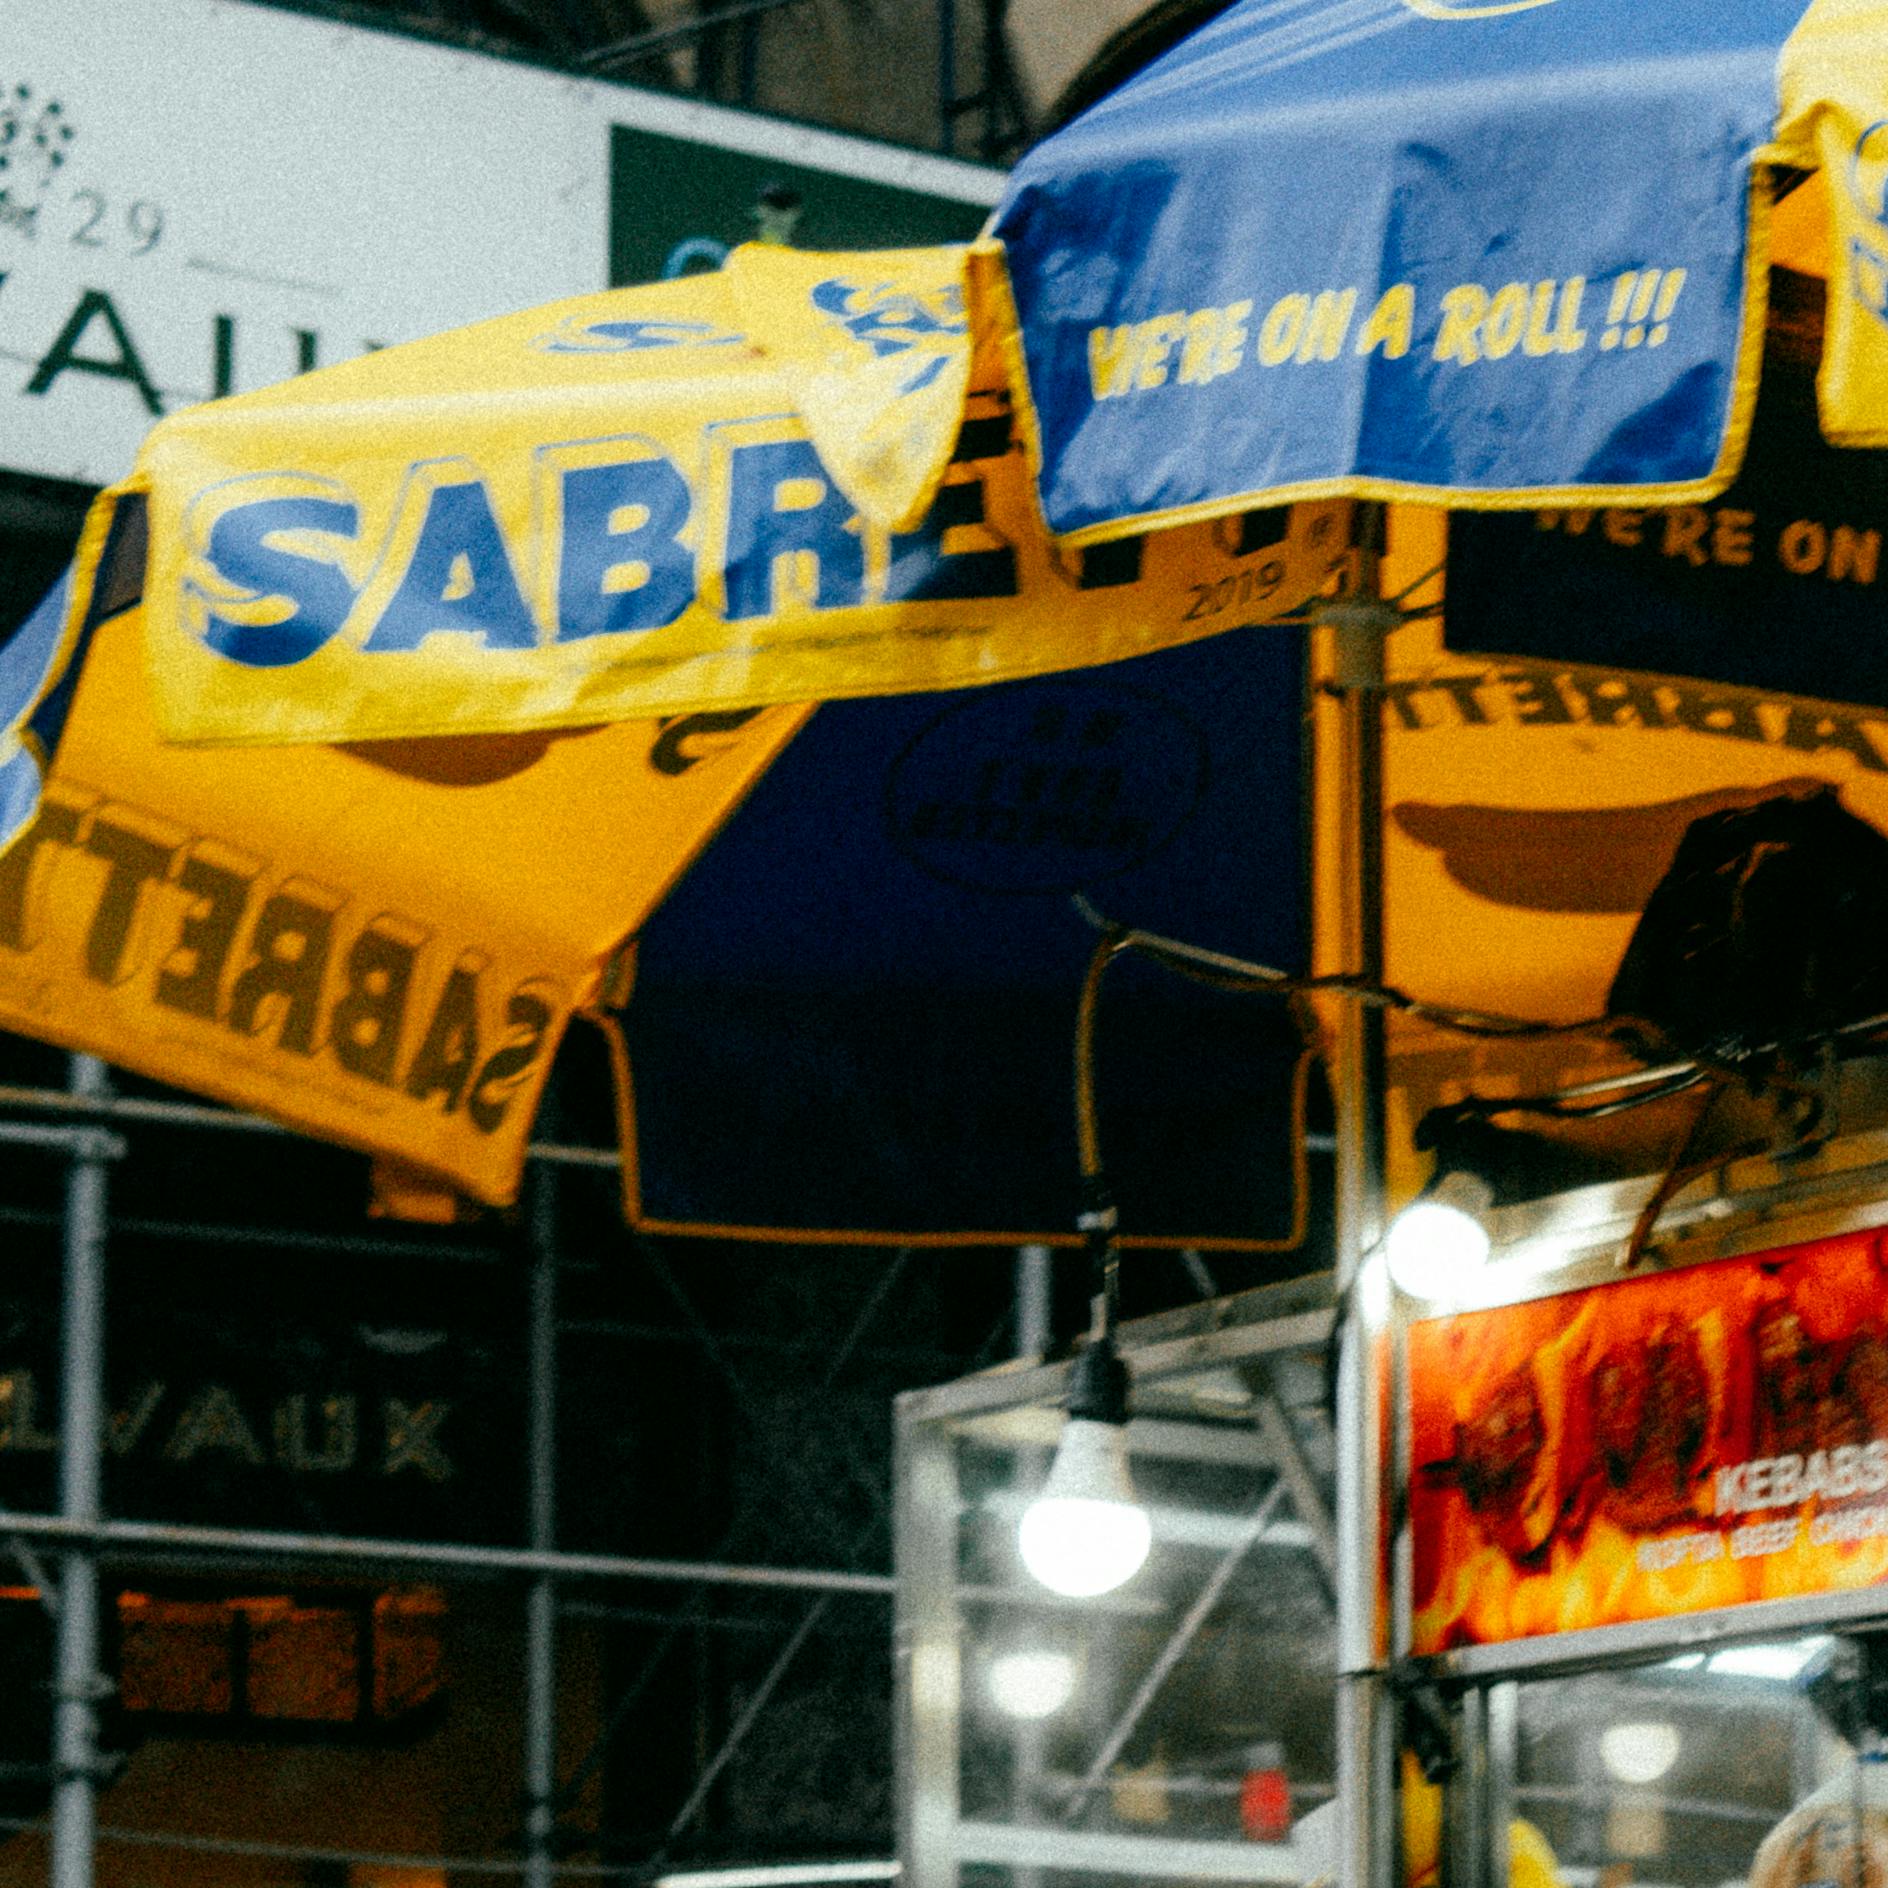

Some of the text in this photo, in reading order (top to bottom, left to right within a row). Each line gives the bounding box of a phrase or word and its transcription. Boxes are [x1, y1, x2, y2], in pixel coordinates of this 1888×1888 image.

[1089, 267, 1687, 400] WE'RE ON A ROLL !!!
[1778, 518, 1882, 585] ON
[1183, 560, 1285, 622] 2019
